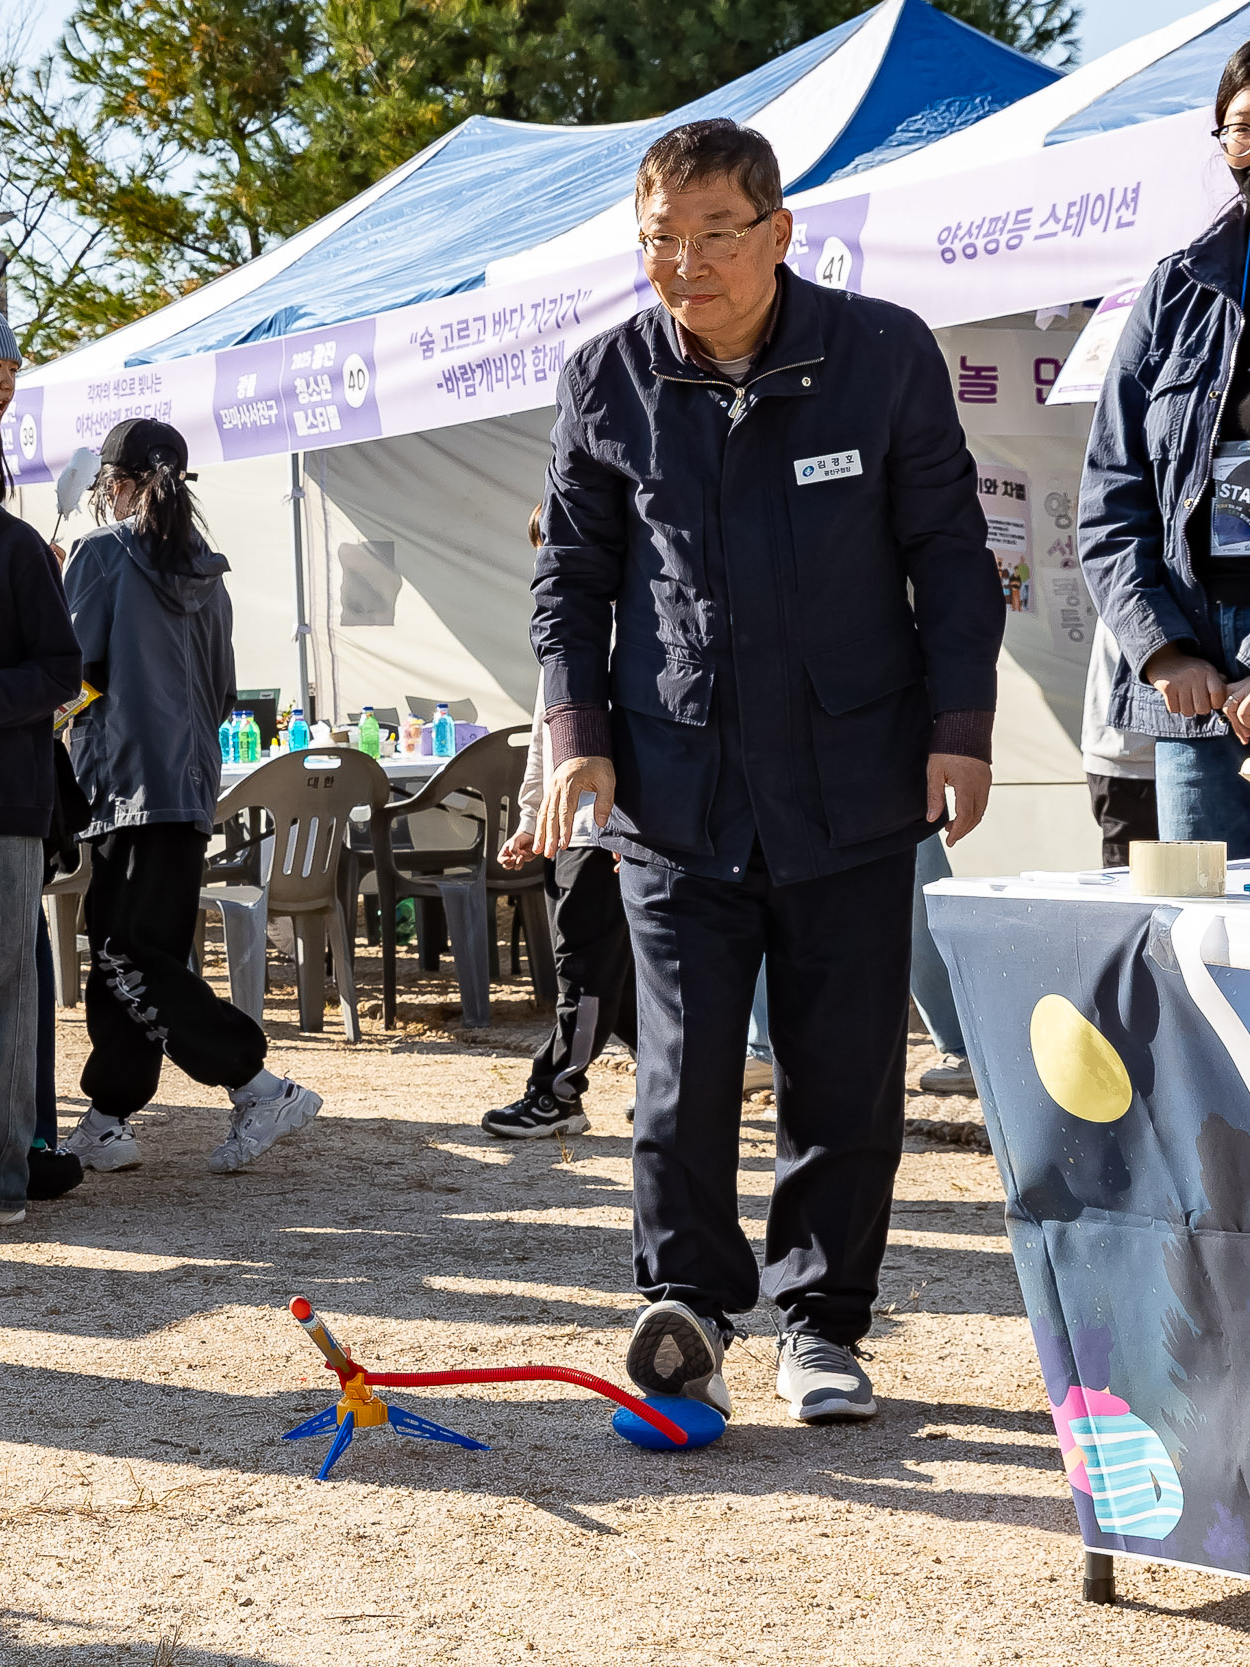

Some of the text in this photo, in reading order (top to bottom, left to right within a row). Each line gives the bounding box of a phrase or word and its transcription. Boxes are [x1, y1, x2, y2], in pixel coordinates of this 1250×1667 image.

[937, 181, 1141, 264] 양성평등 스테이션
[822, 254, 844, 283] 41
[440, 315, 486, 353] 고르고
[492, 303, 525, 342] 바다
[531, 339, 565, 383] 함께
[87, 373, 163, 404] 각자의 색으로 빛나는
[294, 374, 332, 404] 청소년
[348, 368, 366, 392] 40
[23, 427, 34, 446] 39
[1001, 481, 1026, 501] 차별
